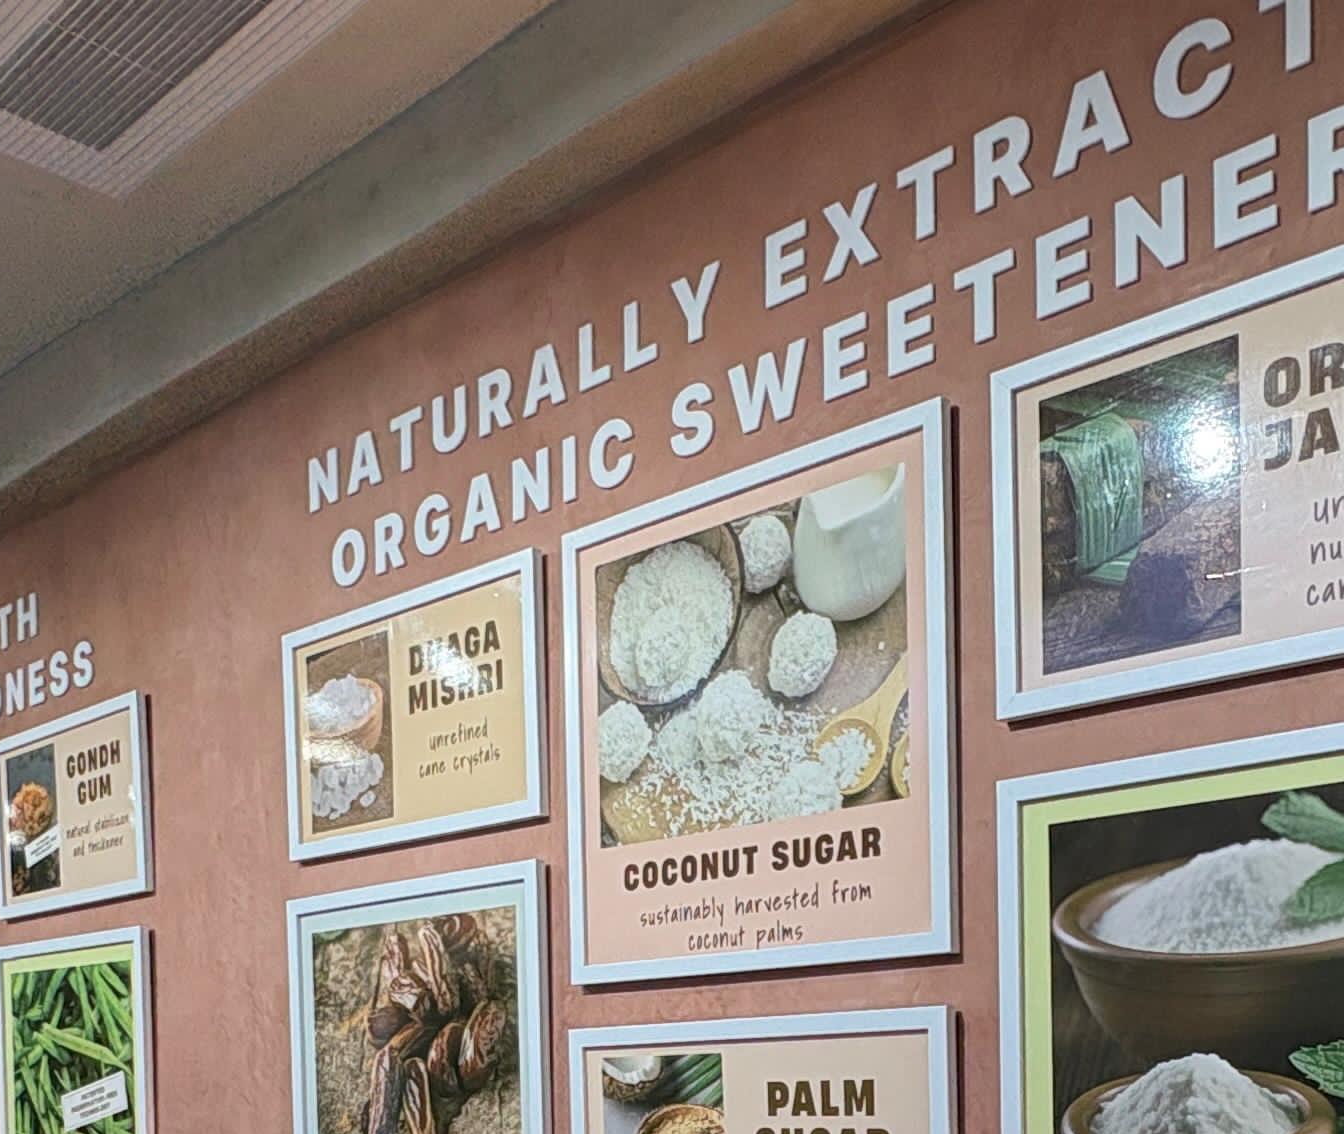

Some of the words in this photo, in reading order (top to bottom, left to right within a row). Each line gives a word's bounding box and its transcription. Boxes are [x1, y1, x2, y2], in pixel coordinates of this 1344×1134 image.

[307, 261, 720, 513] NATURALLY
[331, 418, 634, 588] ORGANIC
[409, 620, 500, 676] DAGA
[429, 717, 488, 751] unrefined
[66, 739, 120, 778] GONDH
[418, 759, 446, 778] cane
[453, 744, 501, 774] crystals
[77, 773, 112, 805] GUM
[624, 845, 758, 891] COCONUT
[771, 827, 882, 871] SUGAR
[640, 899, 724, 928] sustainably
[735, 883, 819, 916] harvested
[832, 879, 872, 904] from
[688, 928, 745, 951] coconut
[756, 920, 804, 949] palms
[767, 1079, 875, 1117] PALM
